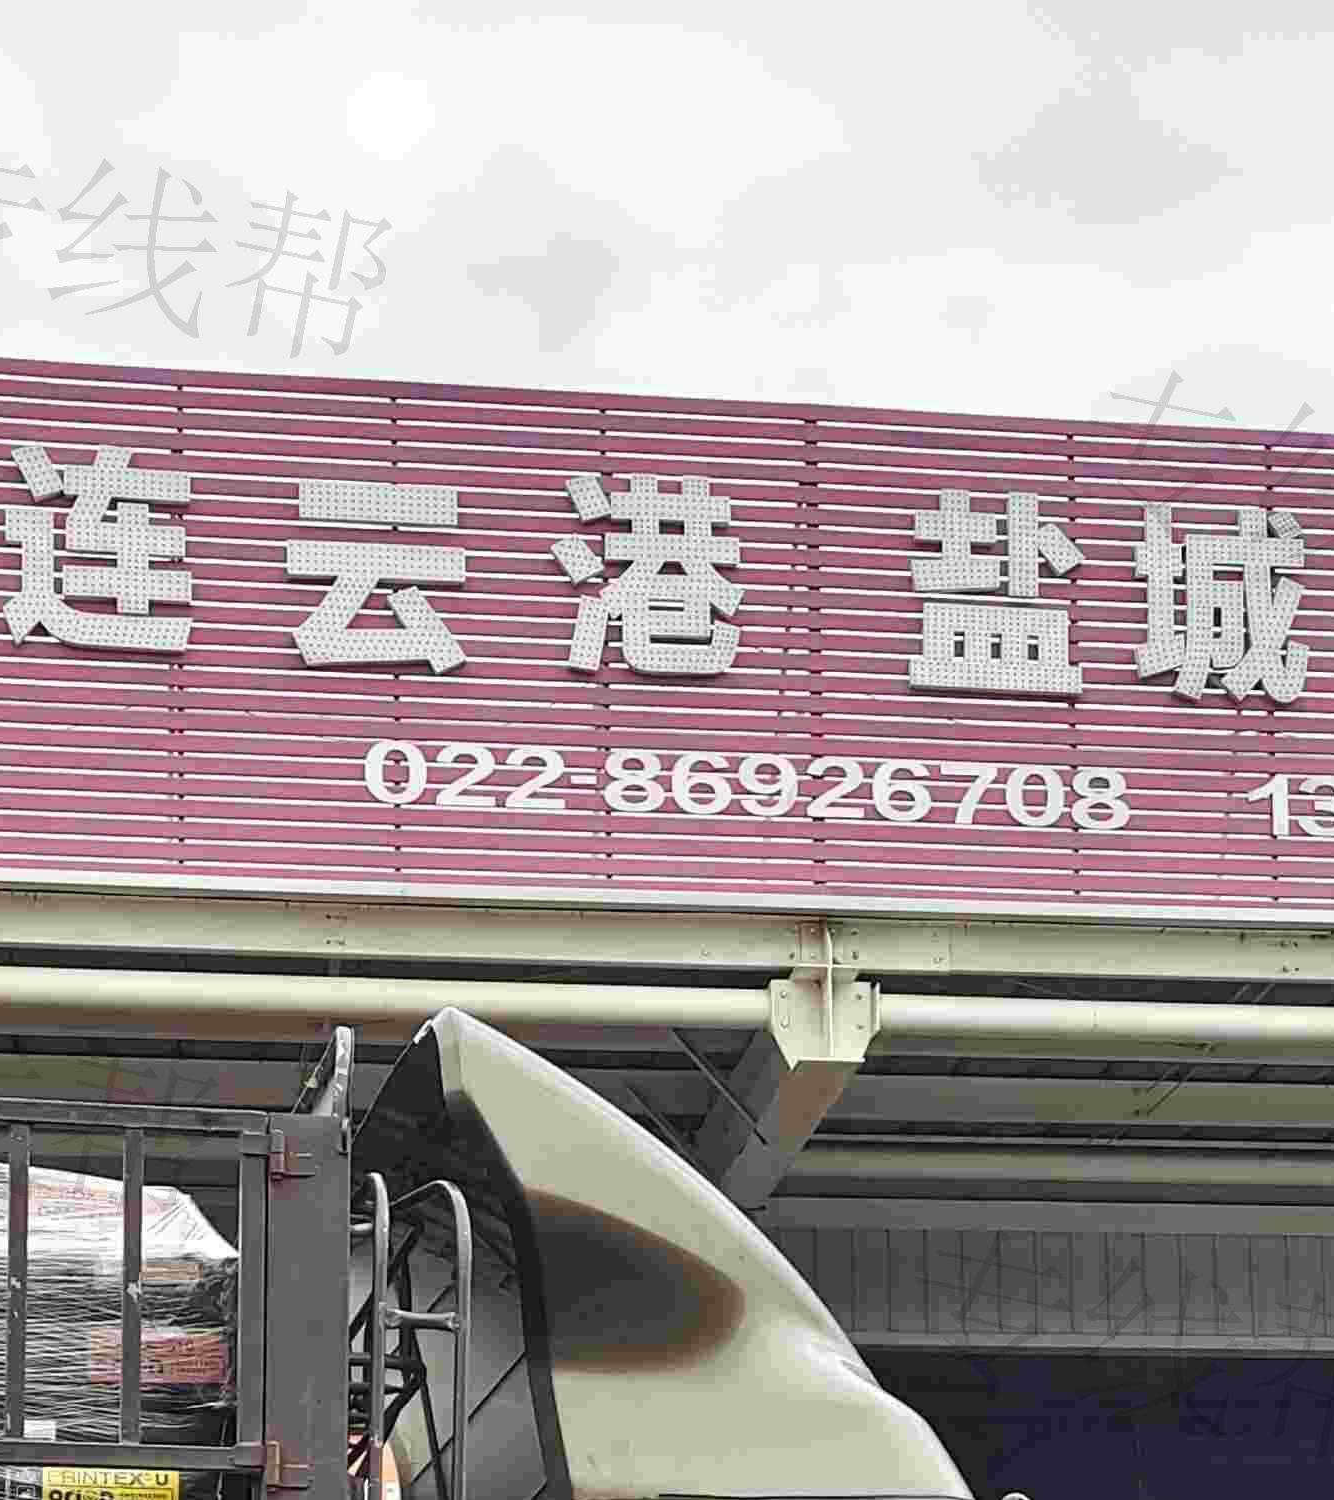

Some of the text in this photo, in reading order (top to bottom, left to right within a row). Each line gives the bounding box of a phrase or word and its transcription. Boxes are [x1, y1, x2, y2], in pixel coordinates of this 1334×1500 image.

[3, 444, 745, 675] 连云港
[908, 488, 1310, 705] 盐城
[364, 739, 1133, 831] 022-86926708
